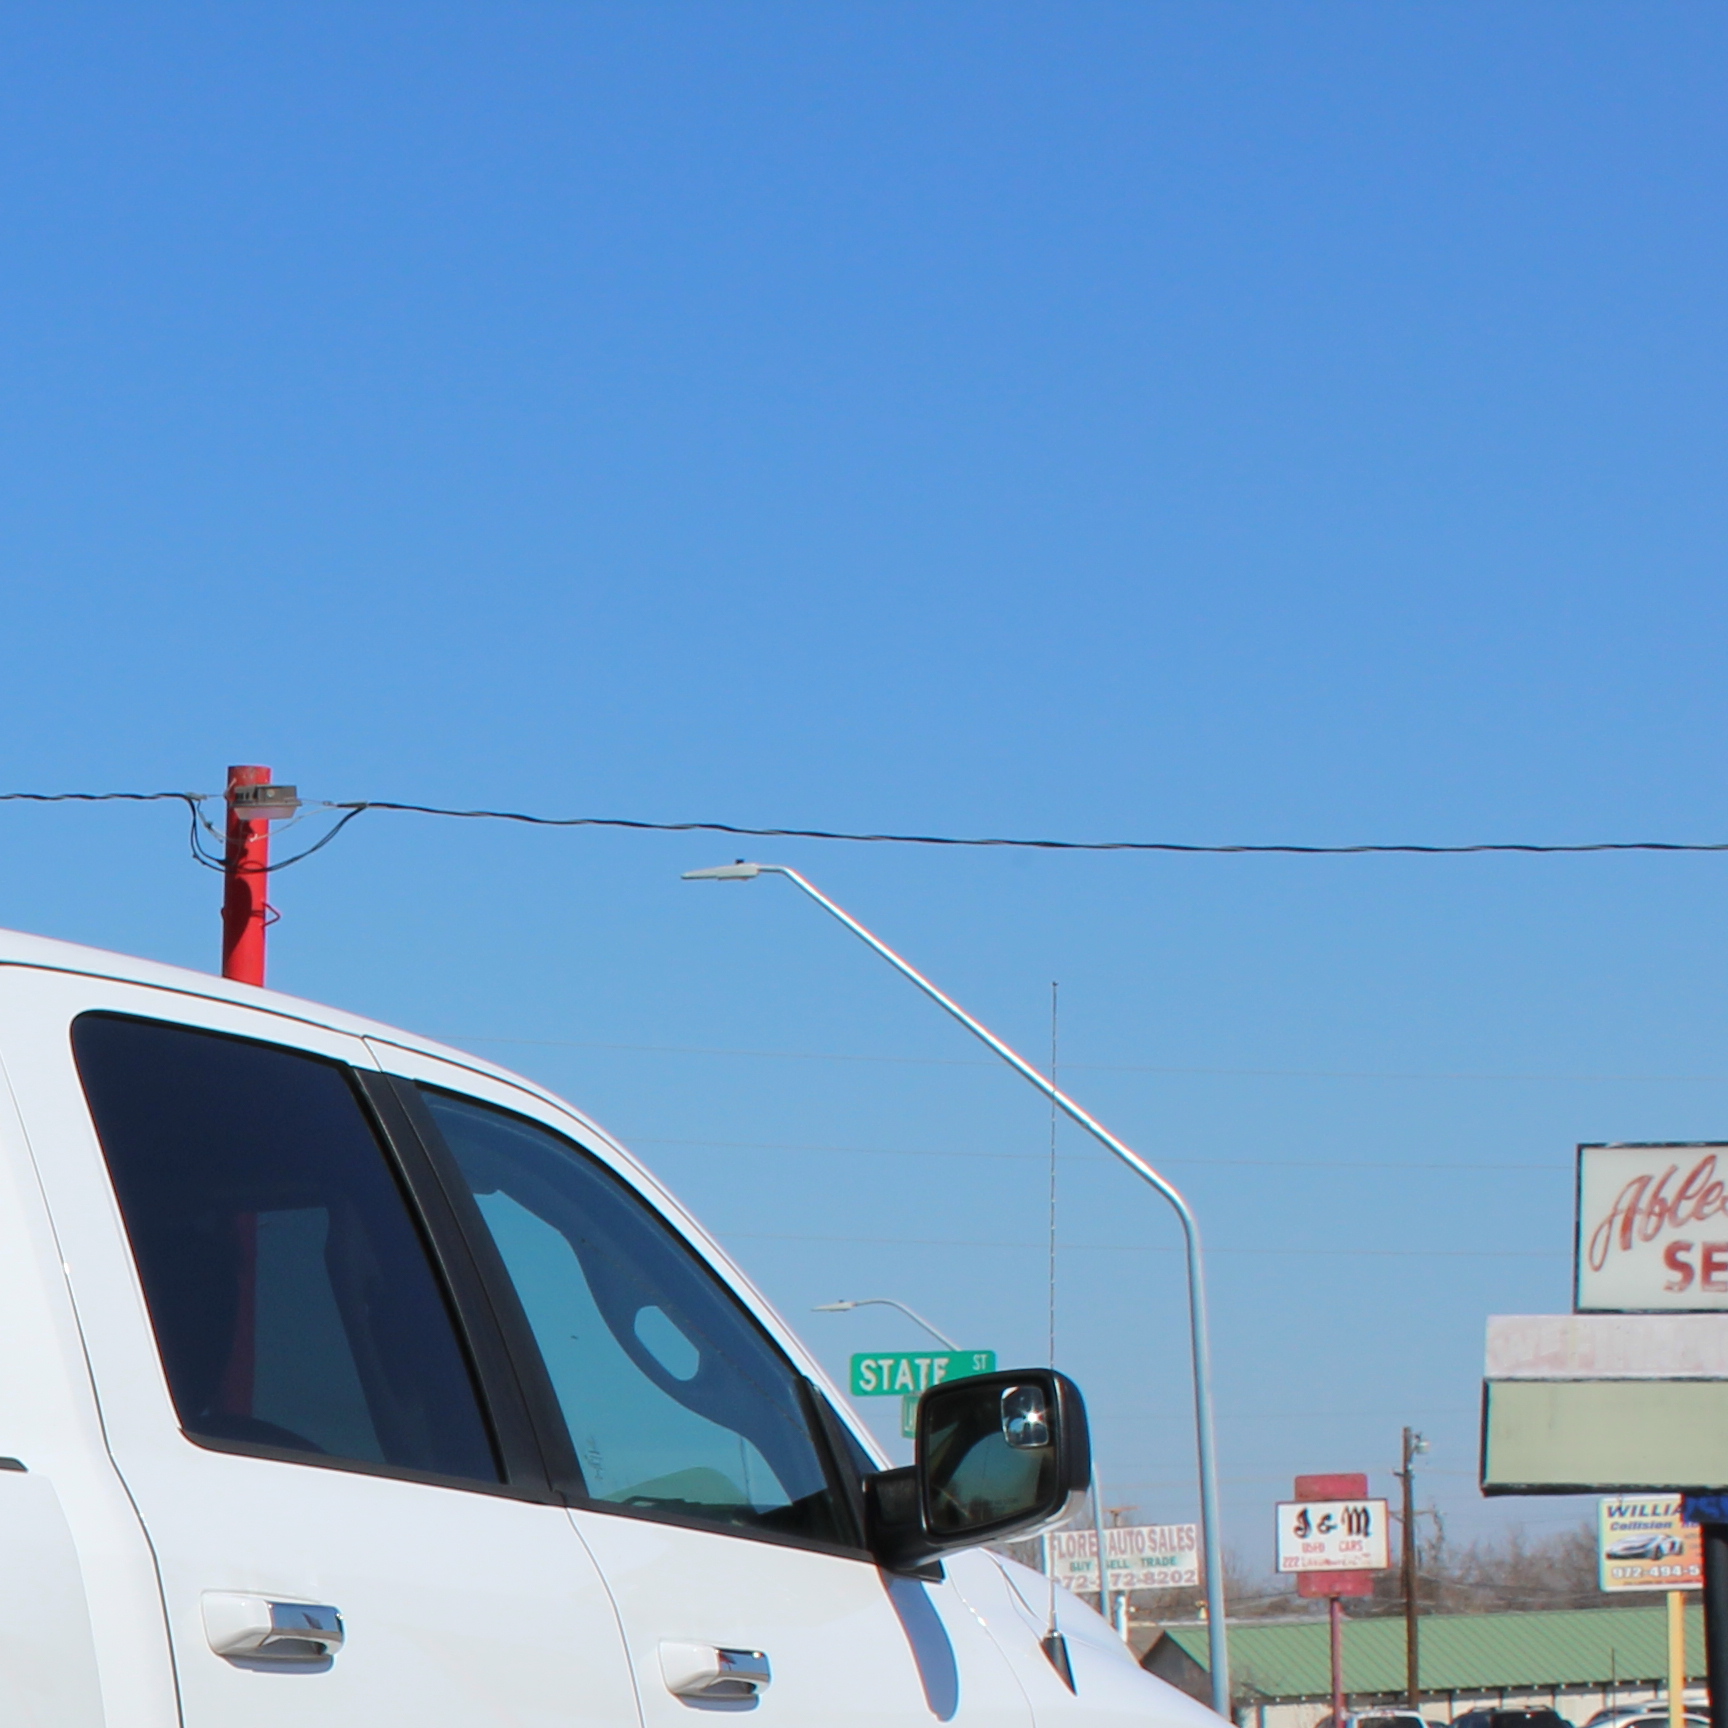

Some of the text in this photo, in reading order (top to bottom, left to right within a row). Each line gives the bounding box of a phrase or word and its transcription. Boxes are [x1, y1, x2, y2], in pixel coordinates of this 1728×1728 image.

[973, 1354, 988, 1371] ST
[1341, 1506, 1372, 1538] M
[1050, 1526, 1195, 1559] FLORE AUTO SALES
[1070, 1561, 1093, 1572] BUY
[1141, 1556, 1177, 1567] TRADE
[1053, 1570, 1195, 1589] 72-72-8202
